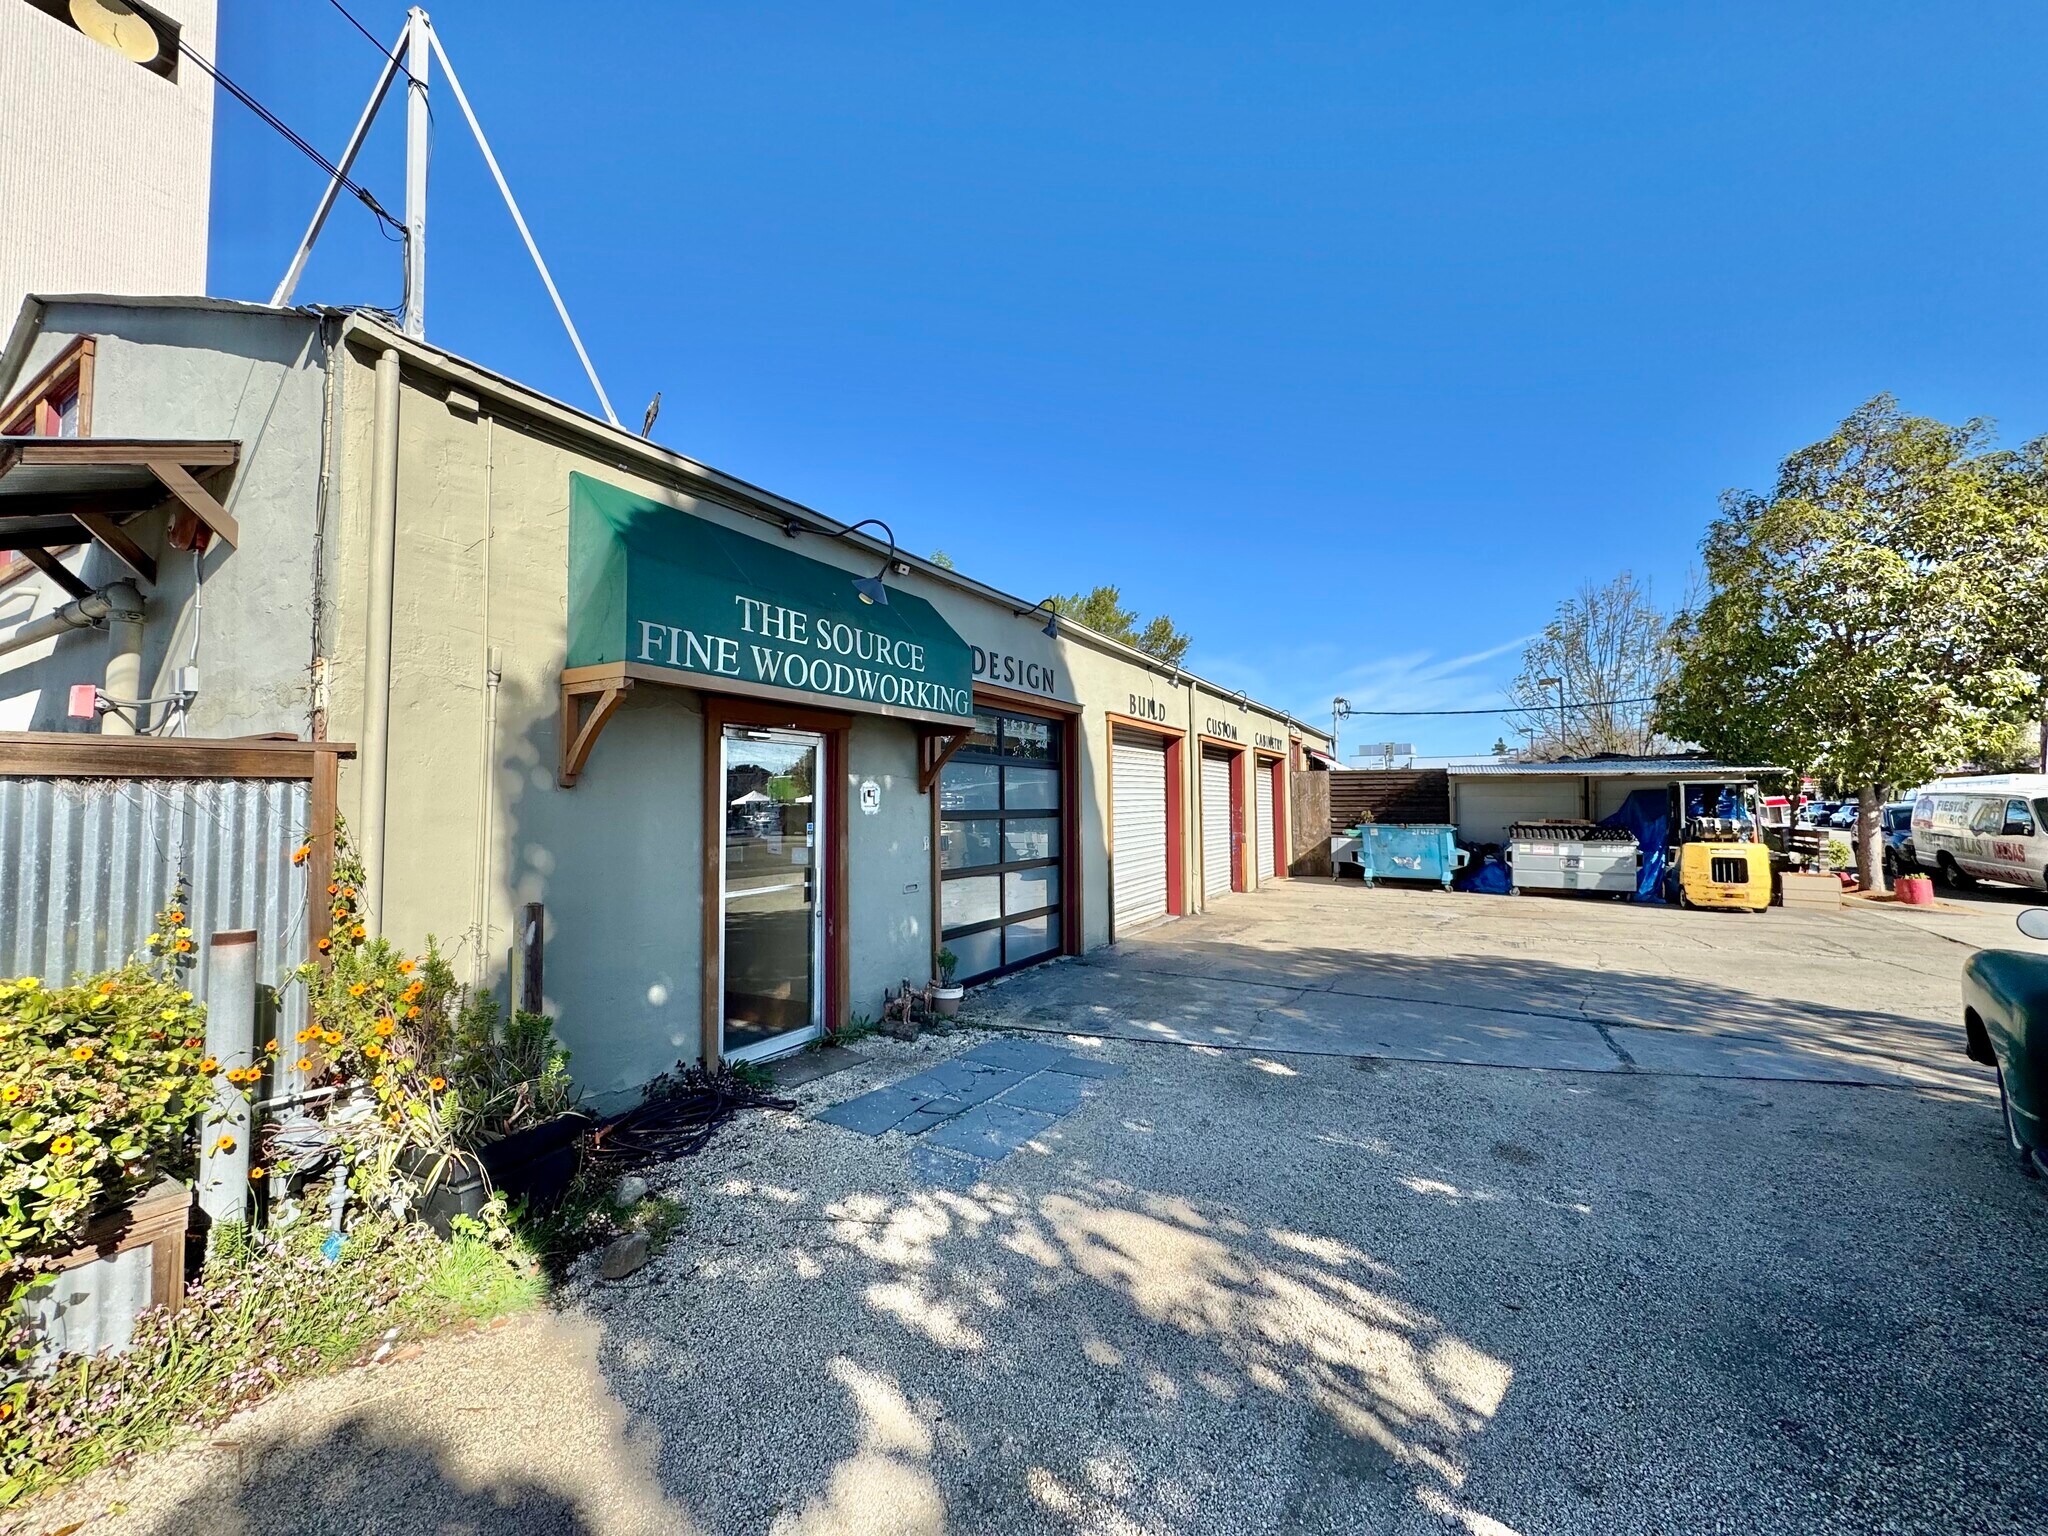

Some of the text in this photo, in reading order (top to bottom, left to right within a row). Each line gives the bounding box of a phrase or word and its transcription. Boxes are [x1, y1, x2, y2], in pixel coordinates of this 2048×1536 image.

[735, 595, 926, 673] THE SOURCE
[637, 619, 969, 716] FINE WOODWORKING
[970, 645, 1055, 695] DESIGN
[1129, 693, 1166, 722] BUILD
[1206, 717, 1238, 740] CUSTOM
[1255, 732, 1283, 751] CABINETRY
[1936, 800, 1970, 813] FIESTAS
